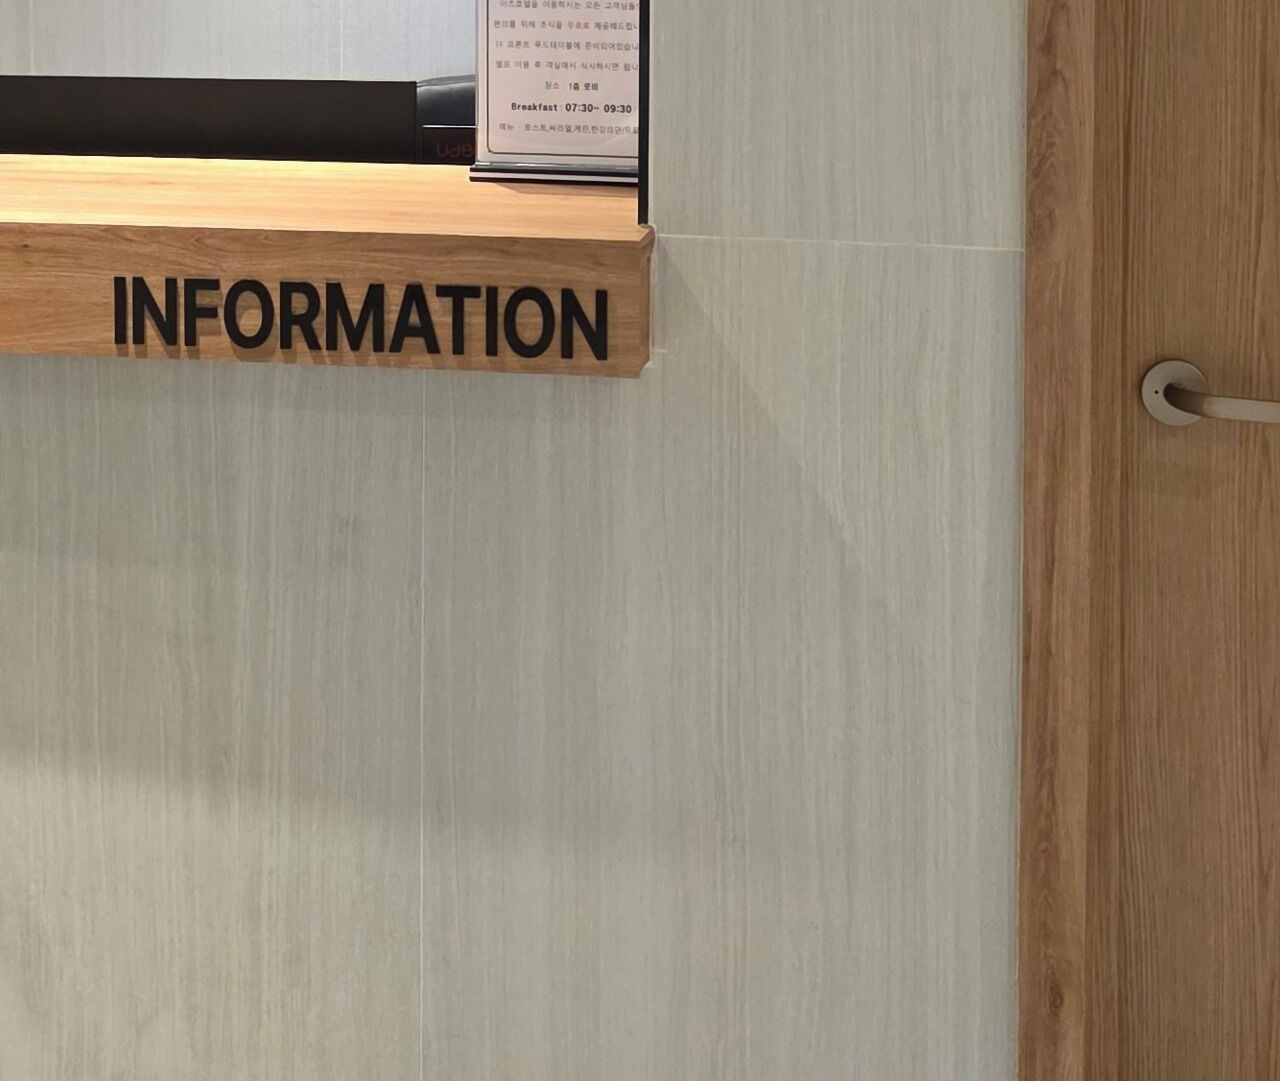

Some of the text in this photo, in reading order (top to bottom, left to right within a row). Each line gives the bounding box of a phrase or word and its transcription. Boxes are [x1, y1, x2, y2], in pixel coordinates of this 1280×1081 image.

[511, 102, 558, 112] Breakfast
[603, 104, 632, 114] 09:30
[114, 276, 608, 360] INFORMATION
